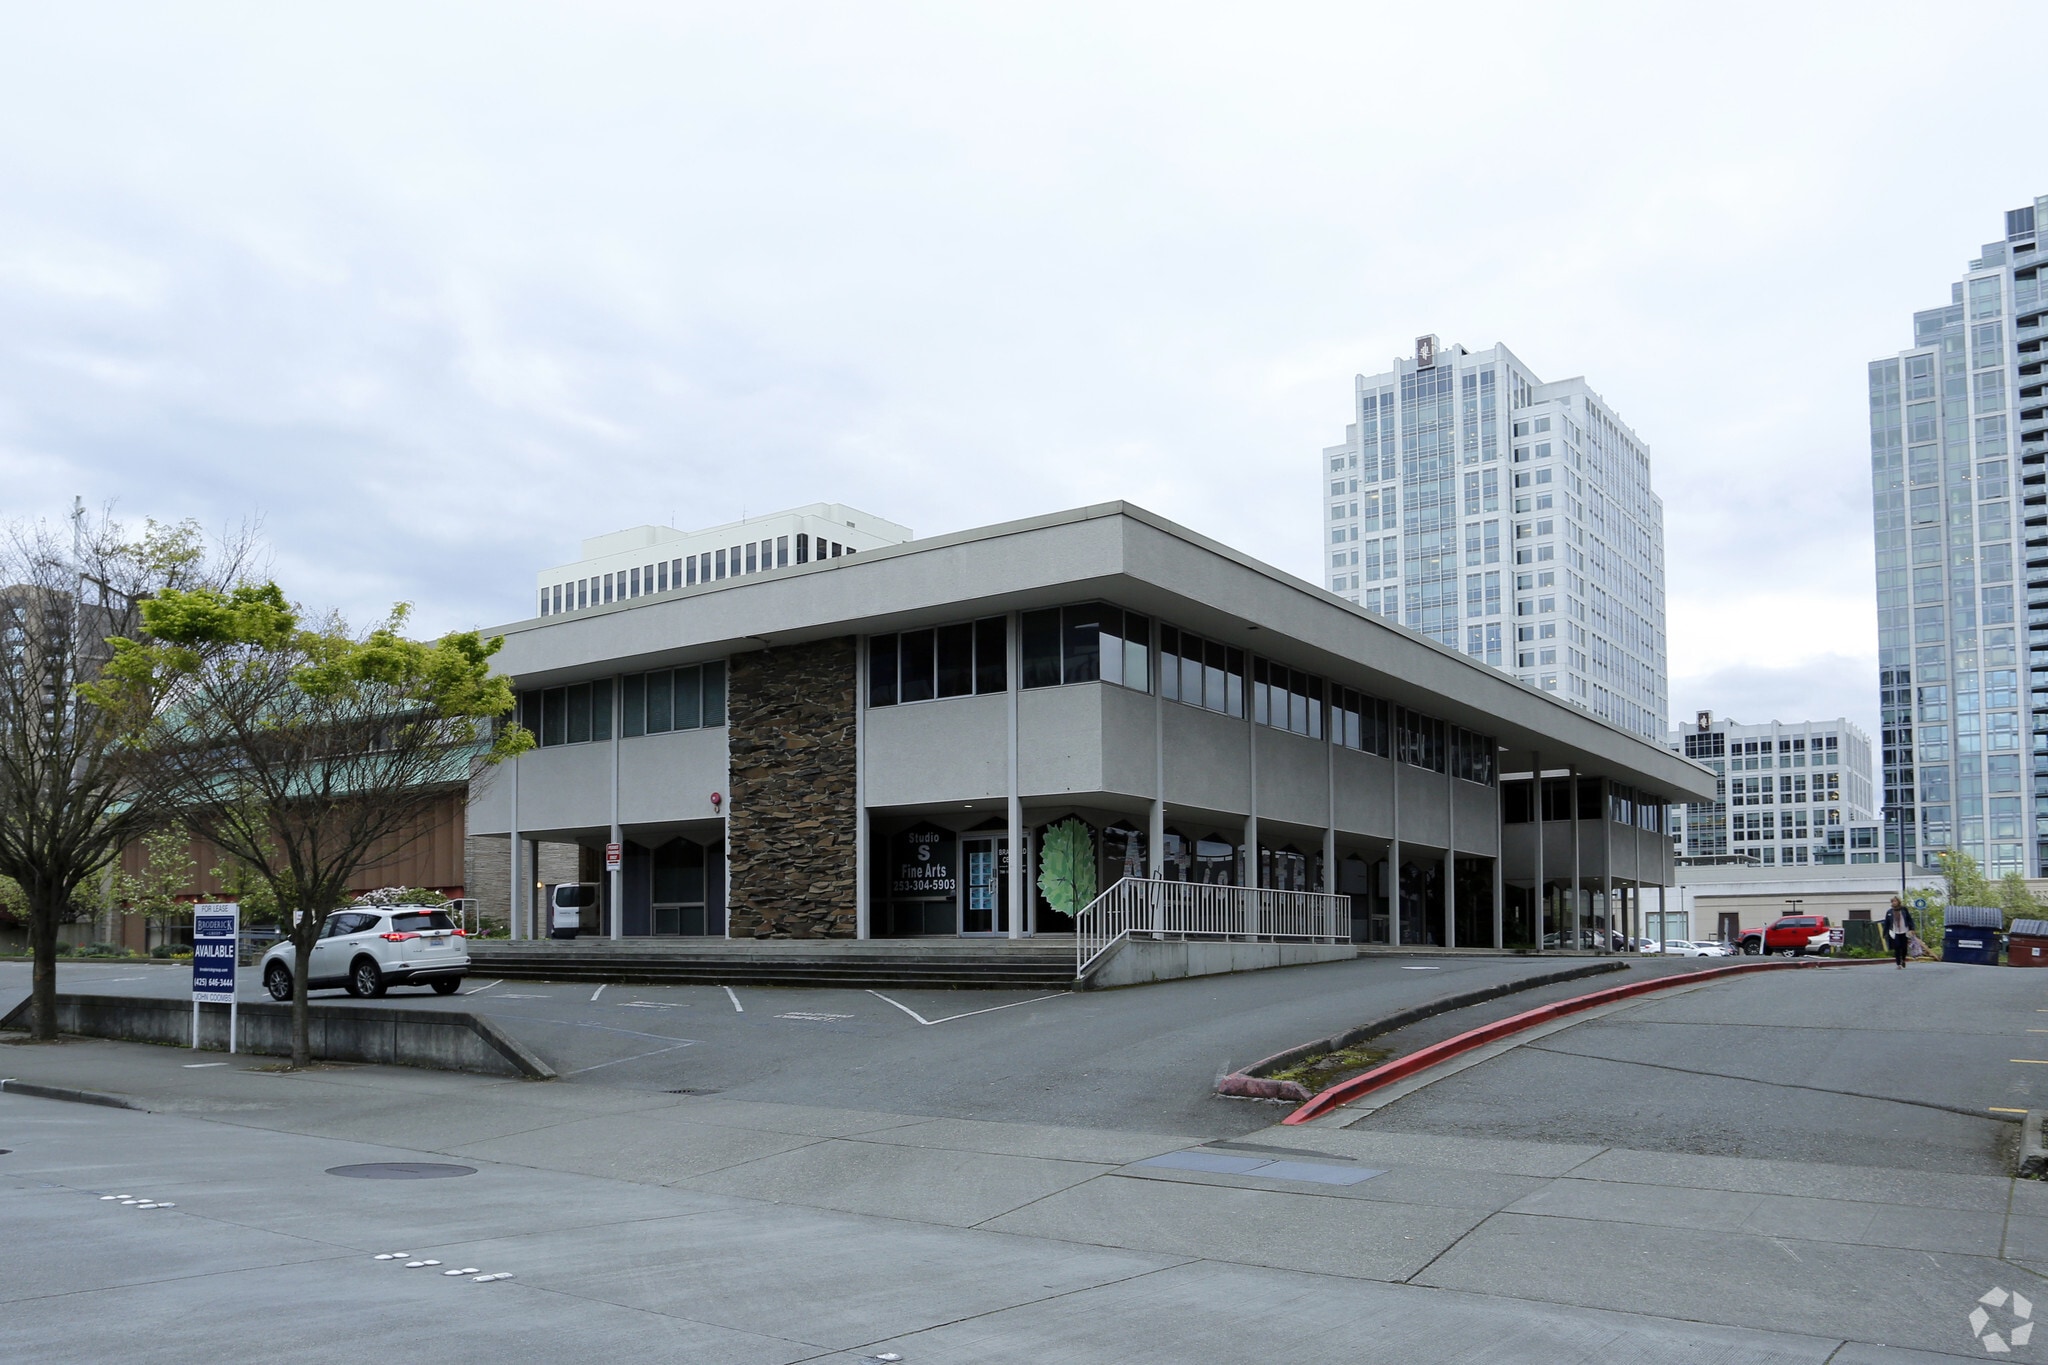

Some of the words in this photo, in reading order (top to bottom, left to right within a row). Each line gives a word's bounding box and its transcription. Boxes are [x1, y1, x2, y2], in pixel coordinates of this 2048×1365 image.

[908, 831, 940, 843] Studio
[917, 844, 931, 861] S
[901, 864, 923, 879] Fine
[924, 863, 947, 878] Arts
[893, 878, 956, 892] 253-304-5903
[213, 904, 229, 912] LEASE
[197, 920, 233, 931] BRODERICK
[194, 944, 234, 958] AVAILABLE
[194, 977, 207, 987] (425)
[208, 977, 233, 987] 646-3444
[194, 993, 209, 1001] JOHN
[210, 993, 232, 1002] COOMBS
